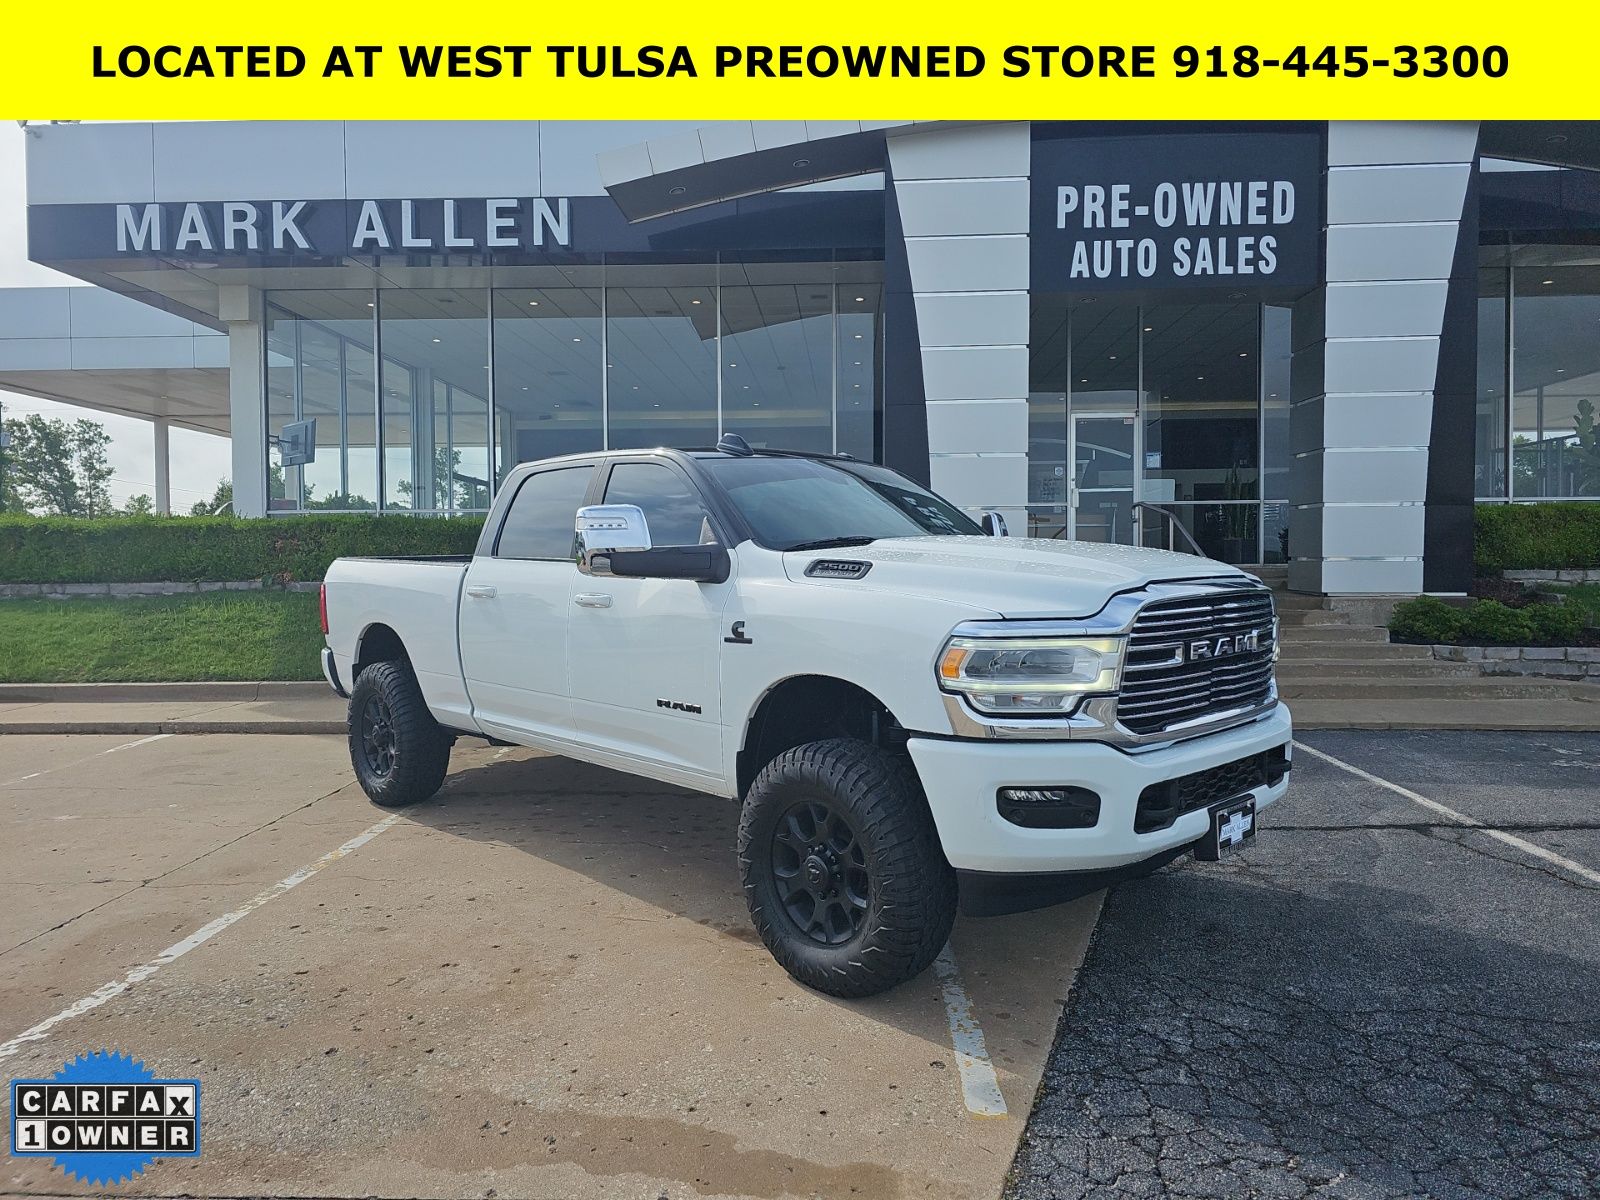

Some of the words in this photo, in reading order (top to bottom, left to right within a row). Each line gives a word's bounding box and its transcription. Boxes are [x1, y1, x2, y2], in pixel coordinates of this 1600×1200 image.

[1056, 180, 1296, 229] PRE-OWNED
[115, 200, 311, 252] MARK
[352, 197, 570, 249] ALLEN
[1069, 238, 1158, 279] AUTO
[1172, 235, 1278, 277] SALES
[818, 562, 860, 572] 2500
[1190, 629, 1259, 660] RAM
[656, 698, 702, 715] RAM
